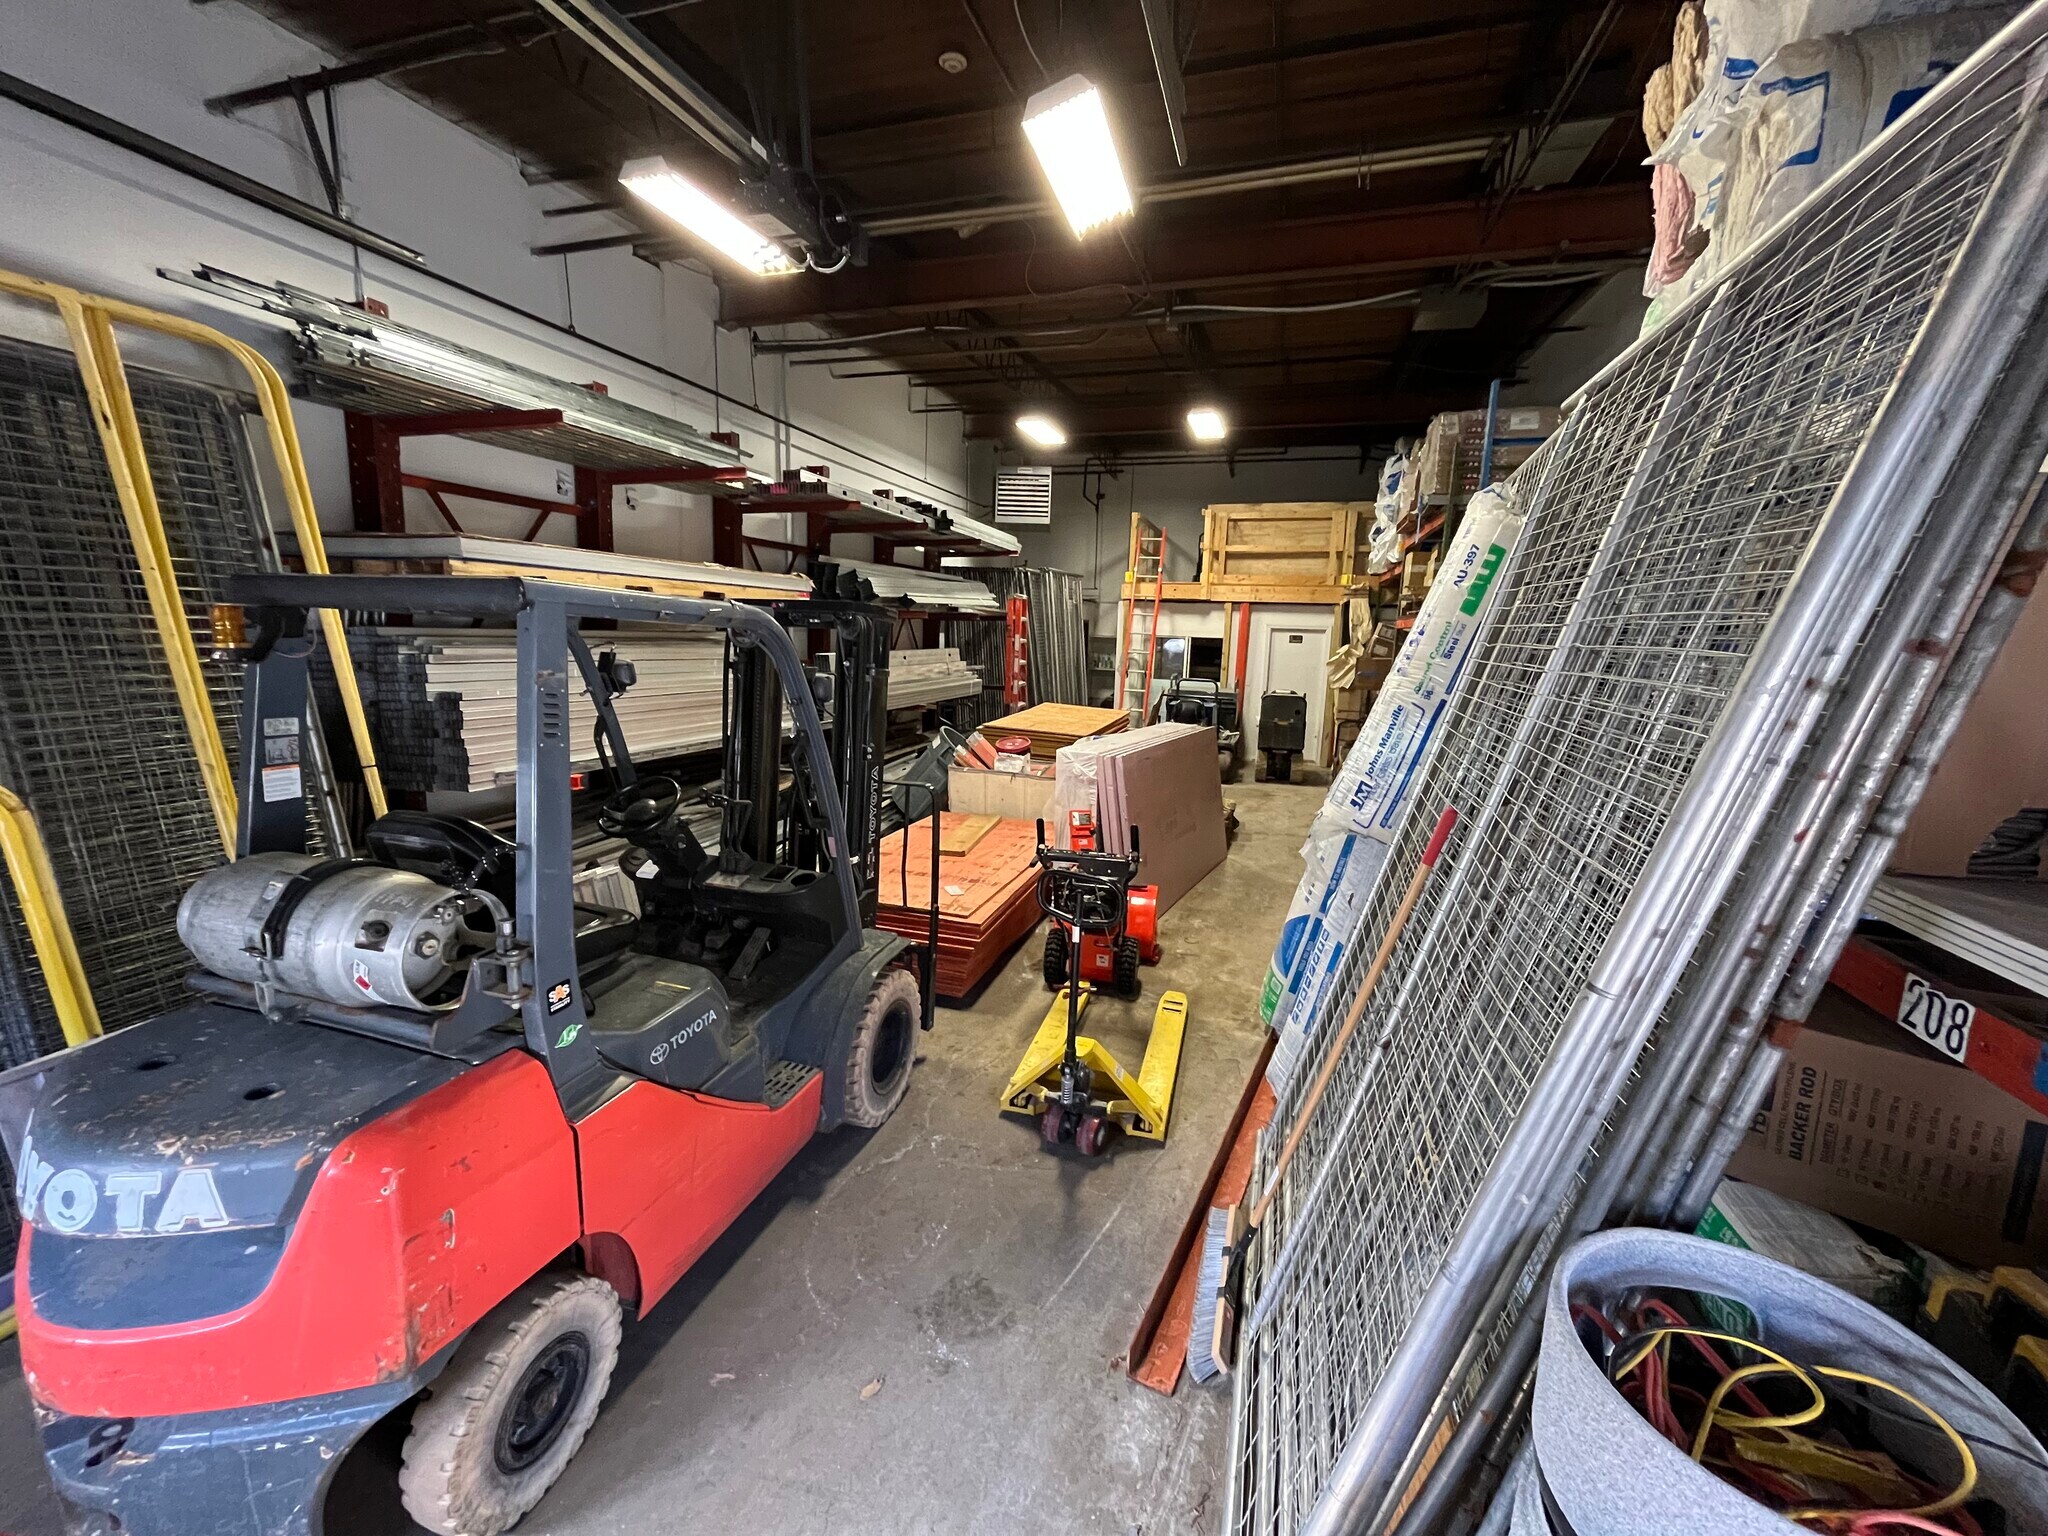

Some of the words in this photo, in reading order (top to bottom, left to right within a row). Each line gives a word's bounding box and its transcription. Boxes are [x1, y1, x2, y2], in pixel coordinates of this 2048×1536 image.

[1454, 544, 1480, 588] AU-397
[1442, 635, 1460, 660] Steel
[1365, 749, 1384, 779] Johns
[1379, 704, 1404, 749] Manville
[867, 766, 879, 843] TOYOTA
[670, 1010, 718, 1050] TOYOTA
[1901, 979, 1969, 1055] 208
[1799, 1066, 1817, 1099] ROD
[1788, 1101, 1812, 1161] BACKER
